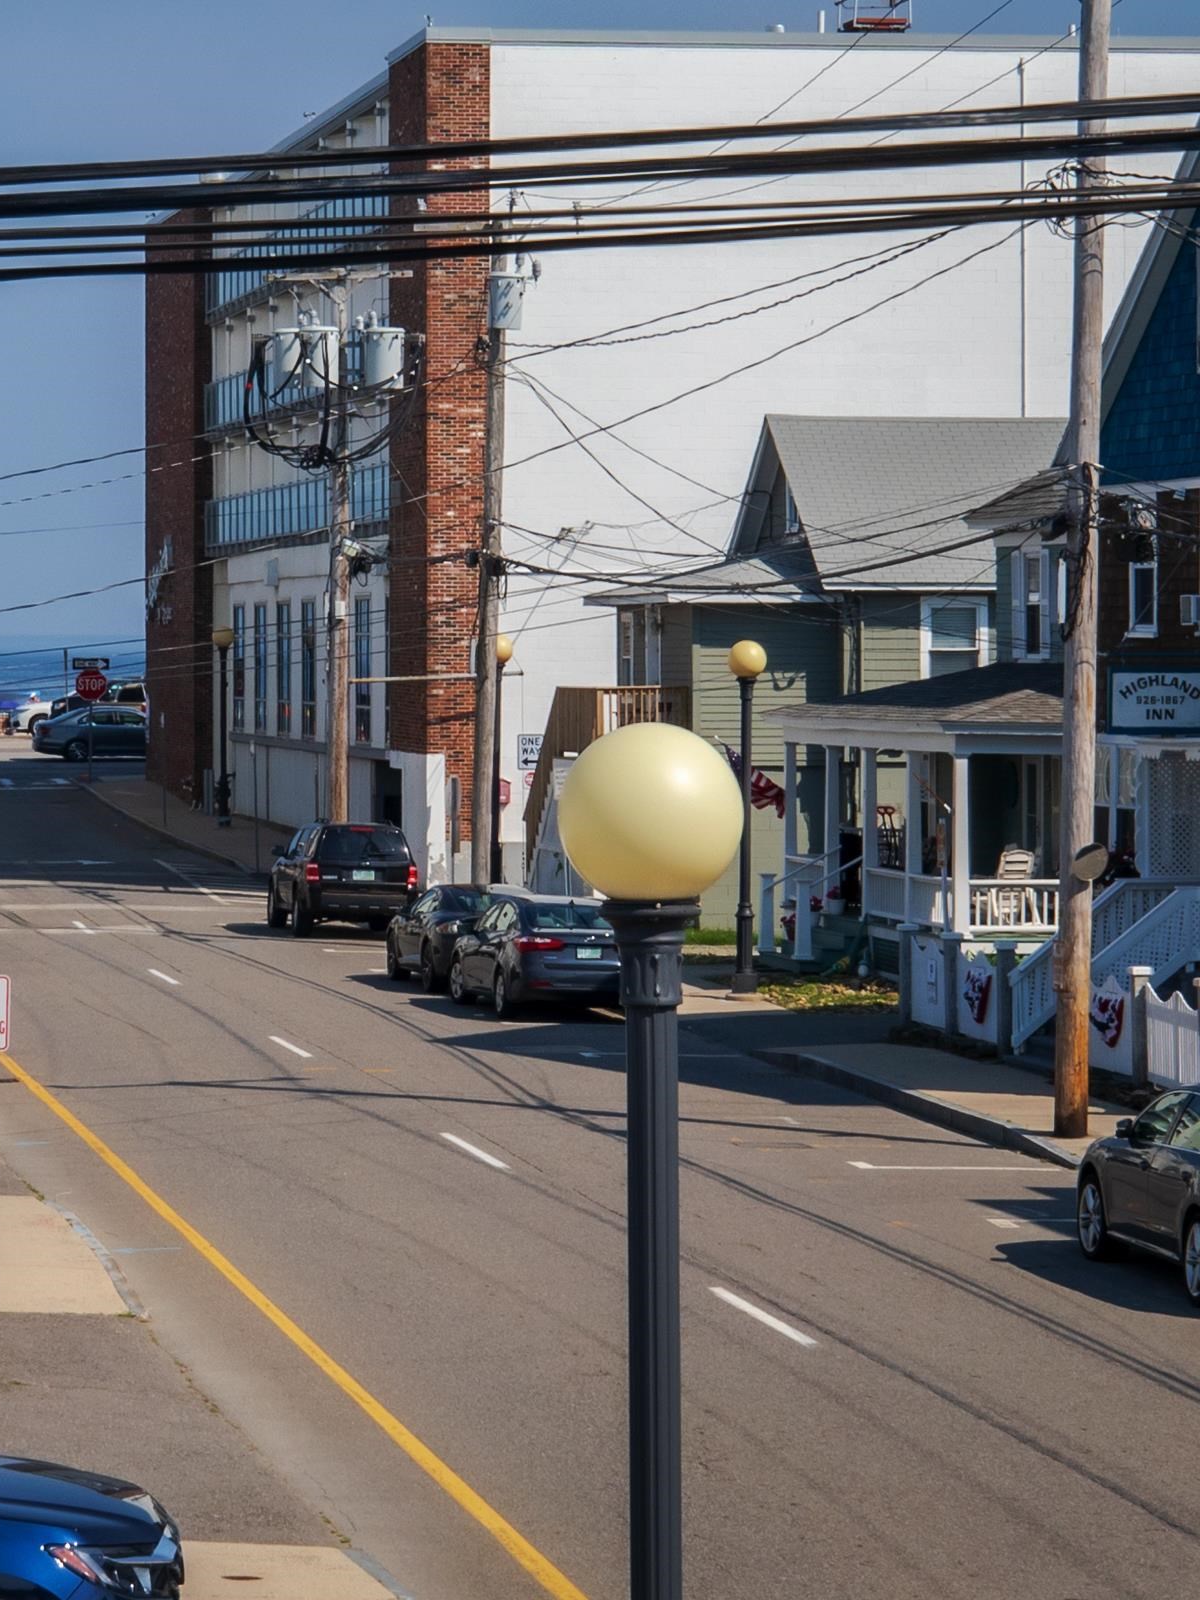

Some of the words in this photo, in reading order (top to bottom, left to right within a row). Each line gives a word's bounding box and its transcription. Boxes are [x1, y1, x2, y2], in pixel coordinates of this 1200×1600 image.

[77, 679, 106, 691] STOP
[1119, 674, 1200, 700] HIGHLAND
[1145, 708, 1176, 721] INN
[521, 736, 541, 746] ONE
